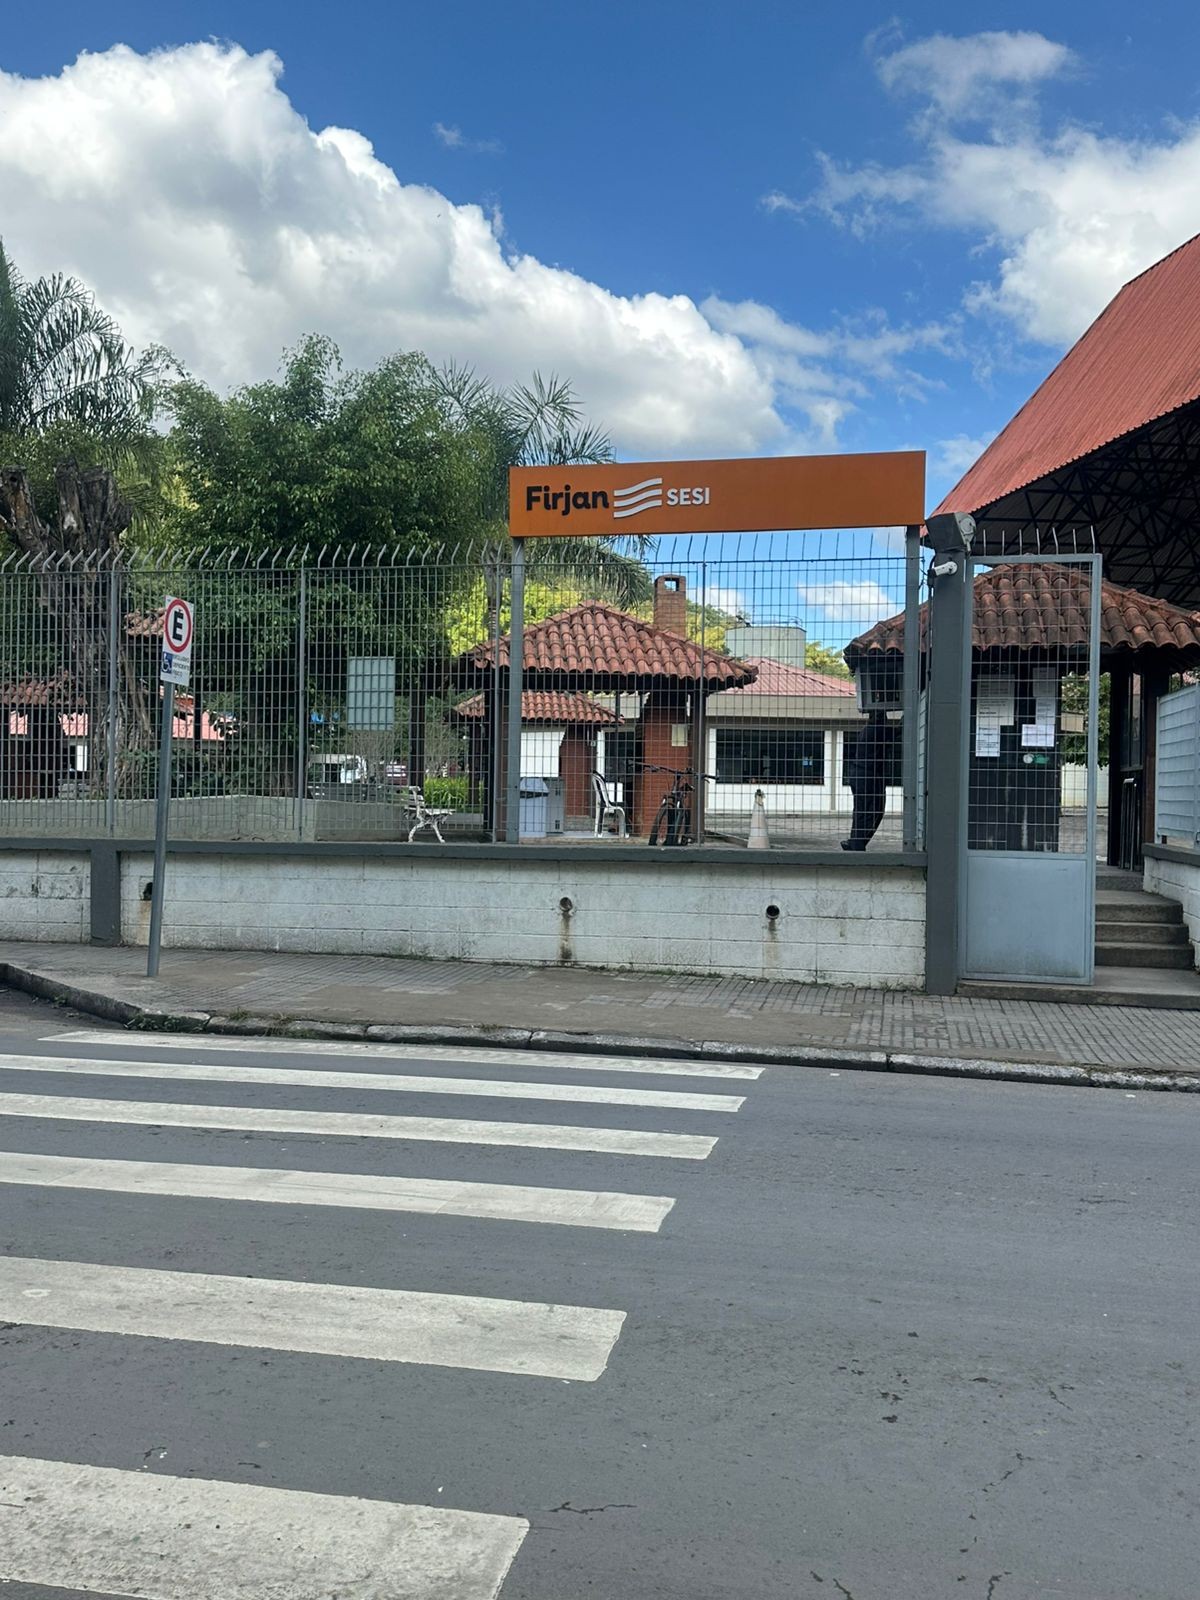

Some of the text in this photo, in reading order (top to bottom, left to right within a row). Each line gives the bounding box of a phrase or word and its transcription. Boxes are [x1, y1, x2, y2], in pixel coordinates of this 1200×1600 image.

[526, 484, 710, 516] Firjan SESI
[172, 610, 184, 641] E
